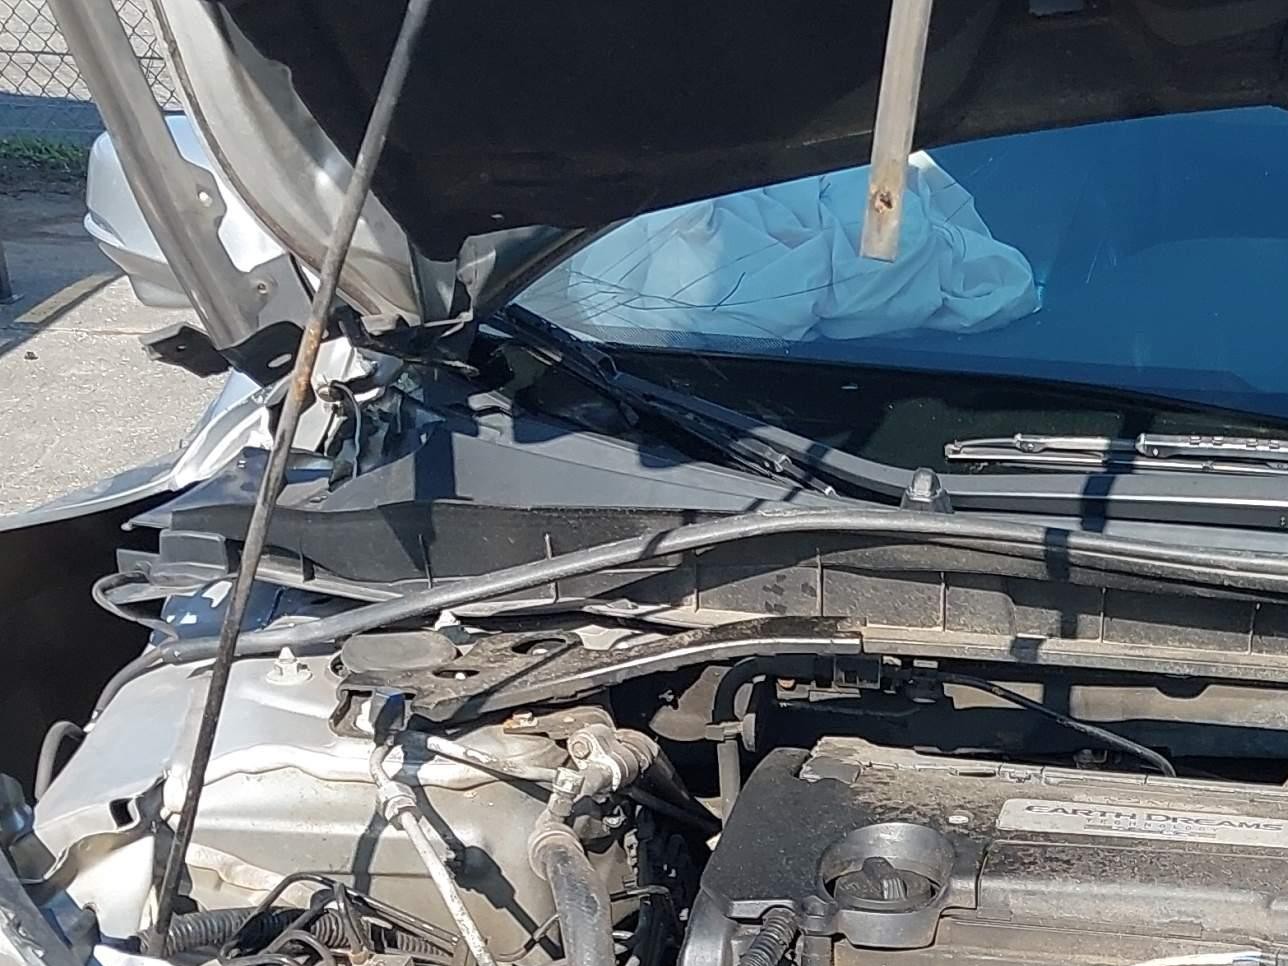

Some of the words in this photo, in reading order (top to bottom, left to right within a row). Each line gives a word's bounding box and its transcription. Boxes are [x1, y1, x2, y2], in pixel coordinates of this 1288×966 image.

[1025, 804, 1137, 821] EARTH
[1145, 812, 1284, 832] DREAMS
[1086, 817, 1217, 833] TECHNOLOGY
